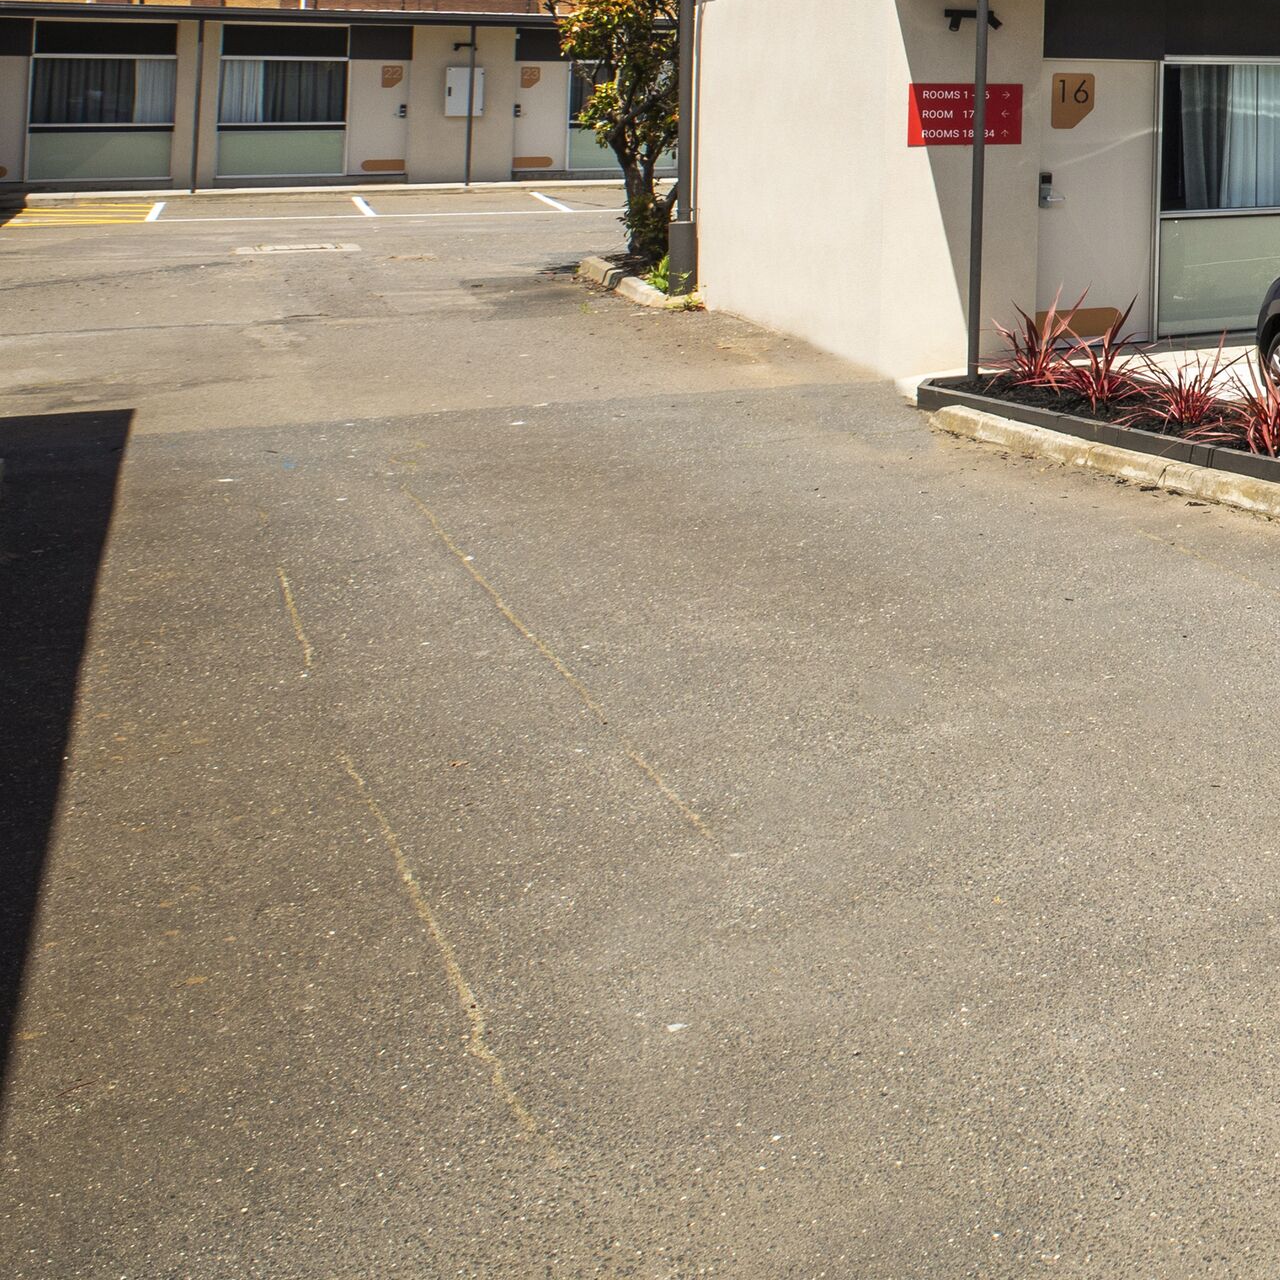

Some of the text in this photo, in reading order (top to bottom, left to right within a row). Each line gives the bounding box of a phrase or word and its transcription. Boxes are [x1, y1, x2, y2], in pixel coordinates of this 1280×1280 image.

[922, 90, 960, 99] ROOMS
[1058, 79, 1089, 104] 16
[922, 110, 974, 118] ROOM 17
[922, 130, 960, 138] ROOMS
[963, 129, 974, 138] 18
